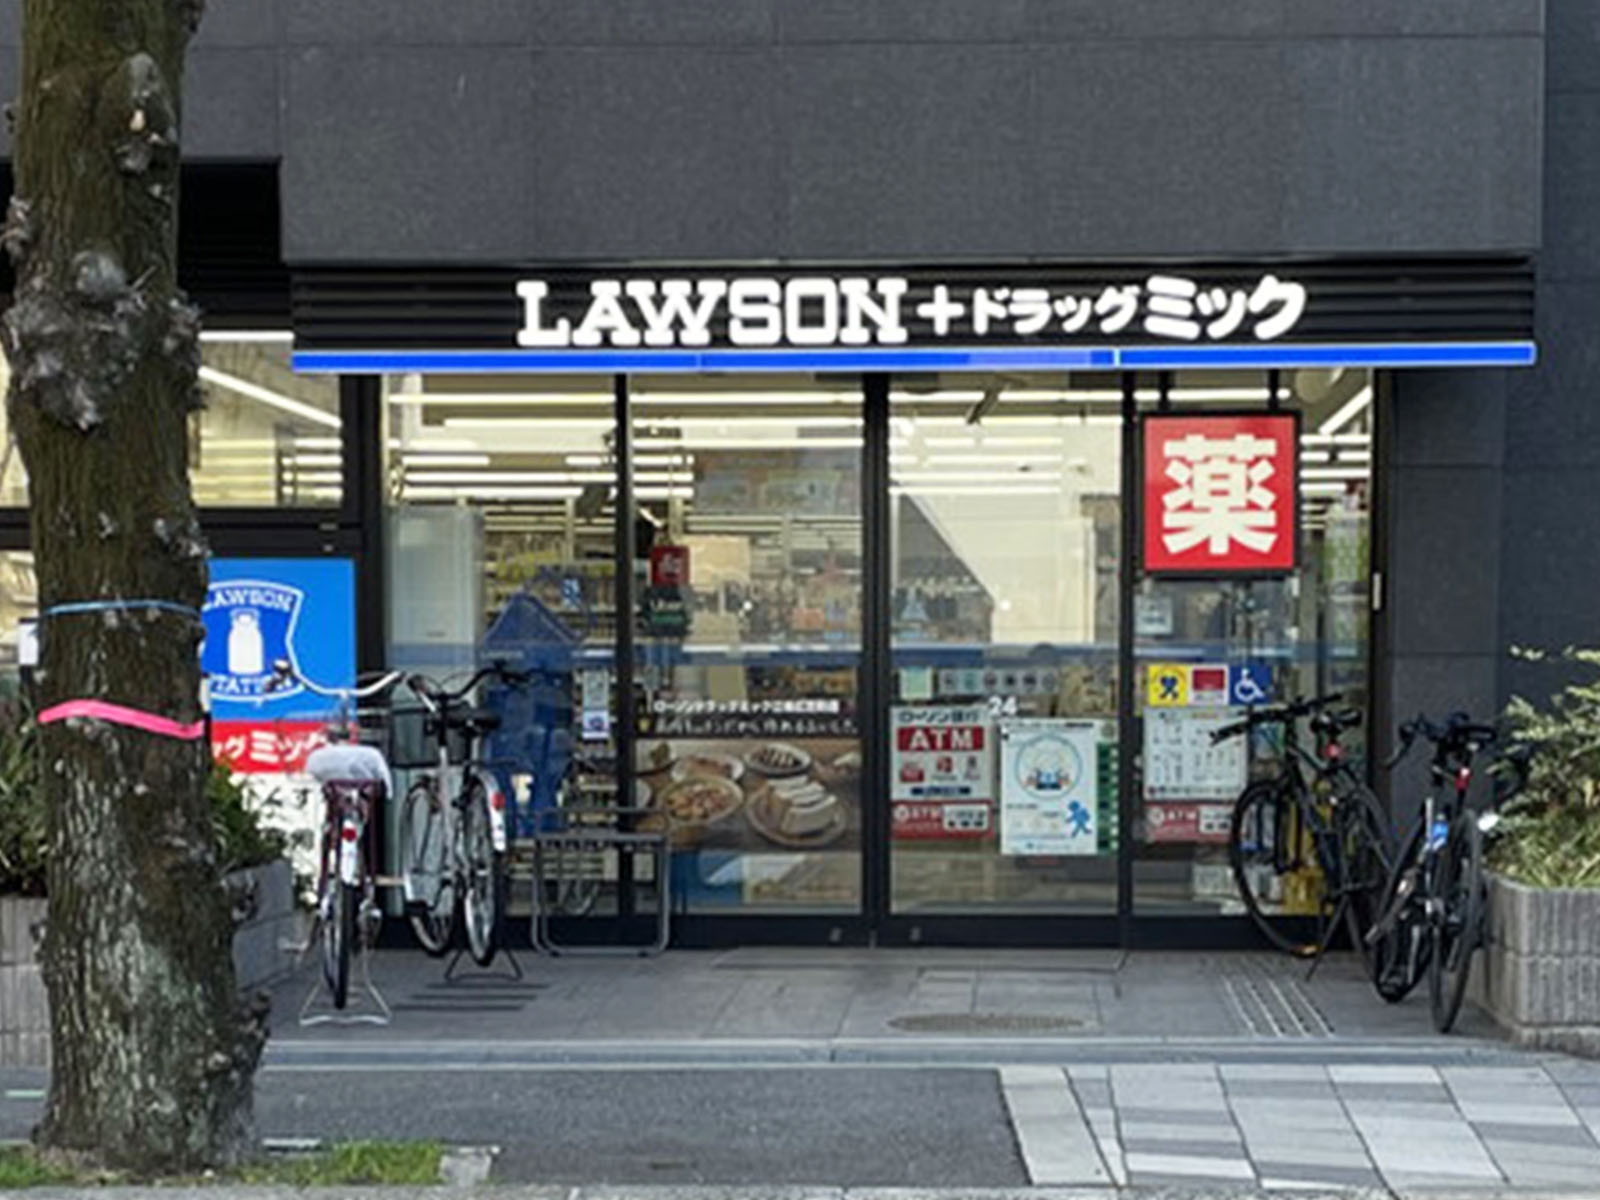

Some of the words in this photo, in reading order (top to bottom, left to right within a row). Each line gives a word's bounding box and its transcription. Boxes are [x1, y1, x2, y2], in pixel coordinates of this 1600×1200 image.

[516, 278, 908, 347] LAWSON
[1162, 433, 1277, 556] 薬
[988, 695, 1018, 715] 24
[908, 729, 973, 751] ATM
